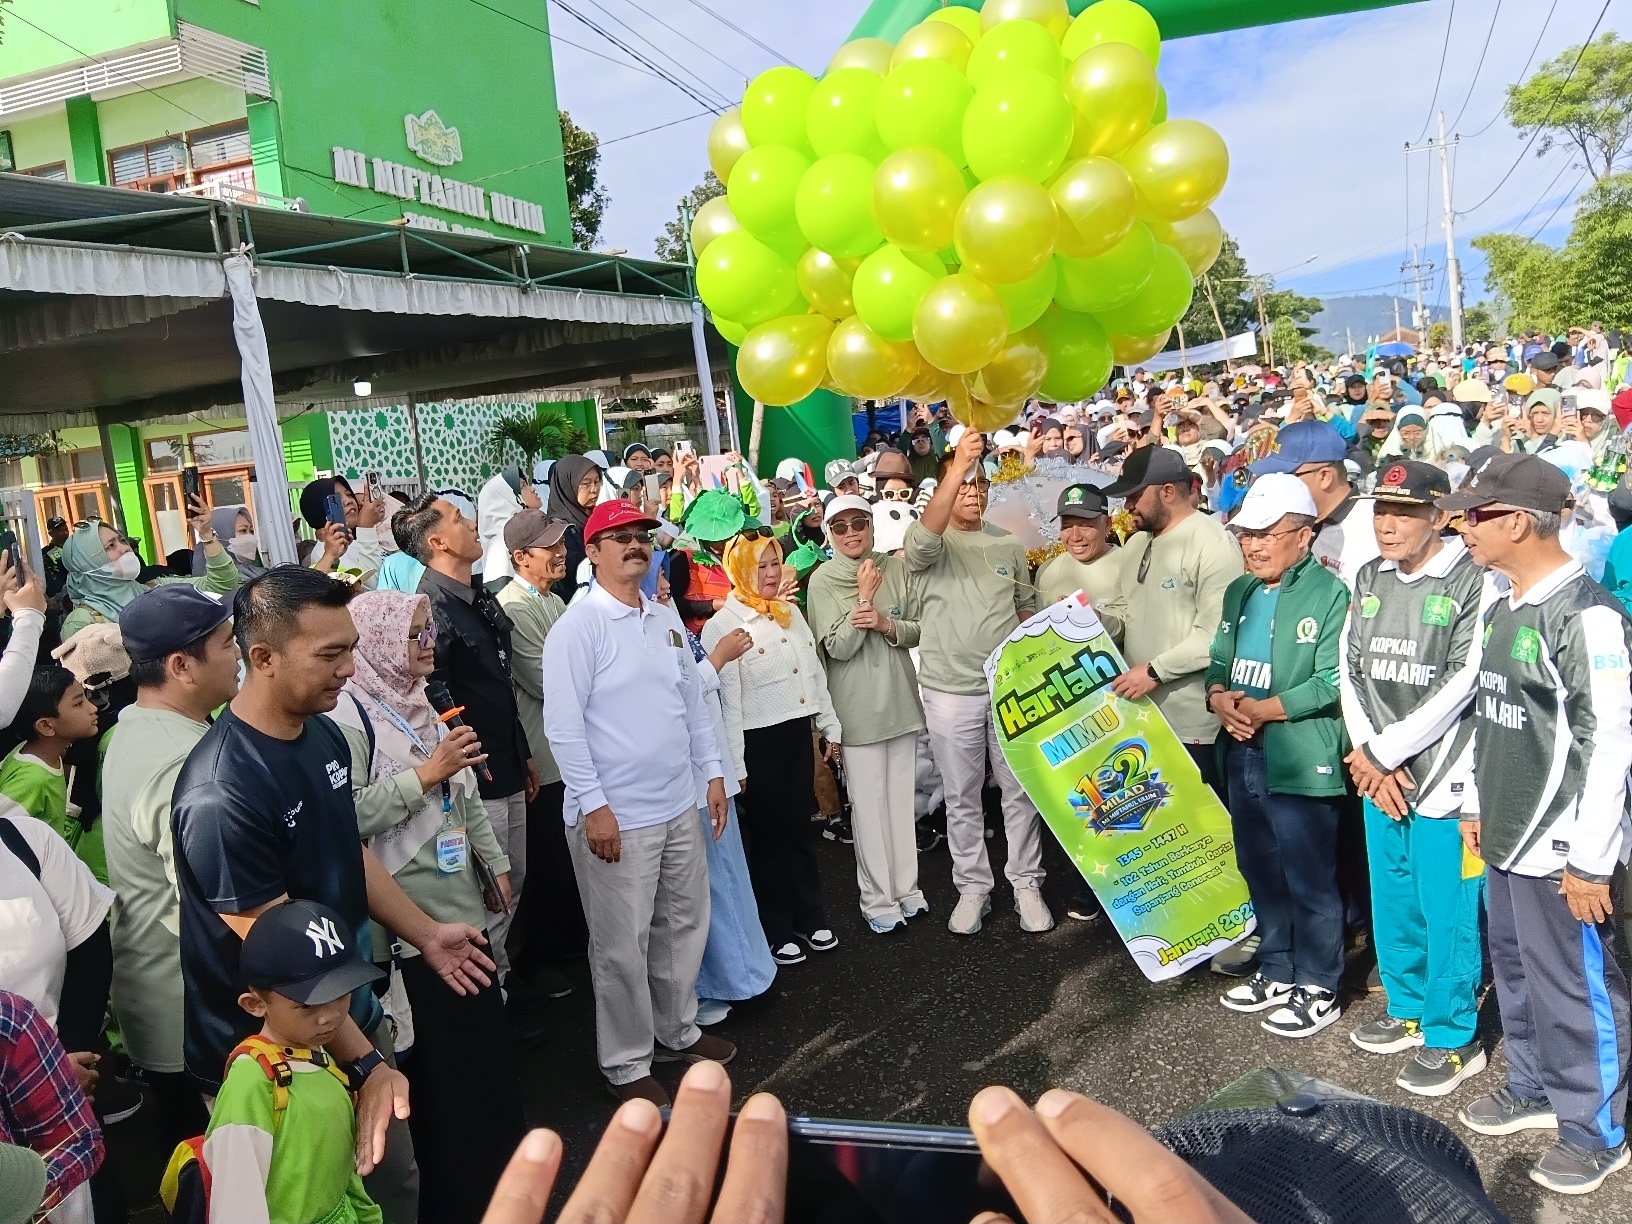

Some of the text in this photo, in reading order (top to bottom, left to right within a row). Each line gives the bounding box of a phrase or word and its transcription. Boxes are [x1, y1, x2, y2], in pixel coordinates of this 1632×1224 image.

[332, 146, 546, 234] MI MIFTAHUL ULUM
[829, 462, 850, 478] NY
[1369, 636, 1418, 657] KOPKAR
[1593, 653, 1624, 670] BSI
[997, 650, 1119, 738] Harlah
[1371, 658, 1437, 687] MAARIF
[1040, 704, 1120, 767] MIMU
[1101, 784, 1145, 813] MILAD
[1116, 847, 1143, 867] 1345
[1150, 829, 1178, 849] 1447
[1177, 823, 1189, 837] H
[1120, 871, 1141, 887] 102
[1138, 859, 1169, 877] Tahun
[1167, 834, 1214, 862] Berkarya
[1111, 887, 1147, 909] dengan
[1166, 856, 1207, 880] Tumbuh
[1205, 841, 1233, 861] Ceria
[1132, 886, 1181, 917] Sepanjang
[1179, 866, 1223, 892] Generasi
[305, 916, 345, 959] NY
[1157, 923, 1221, 966] Januari
